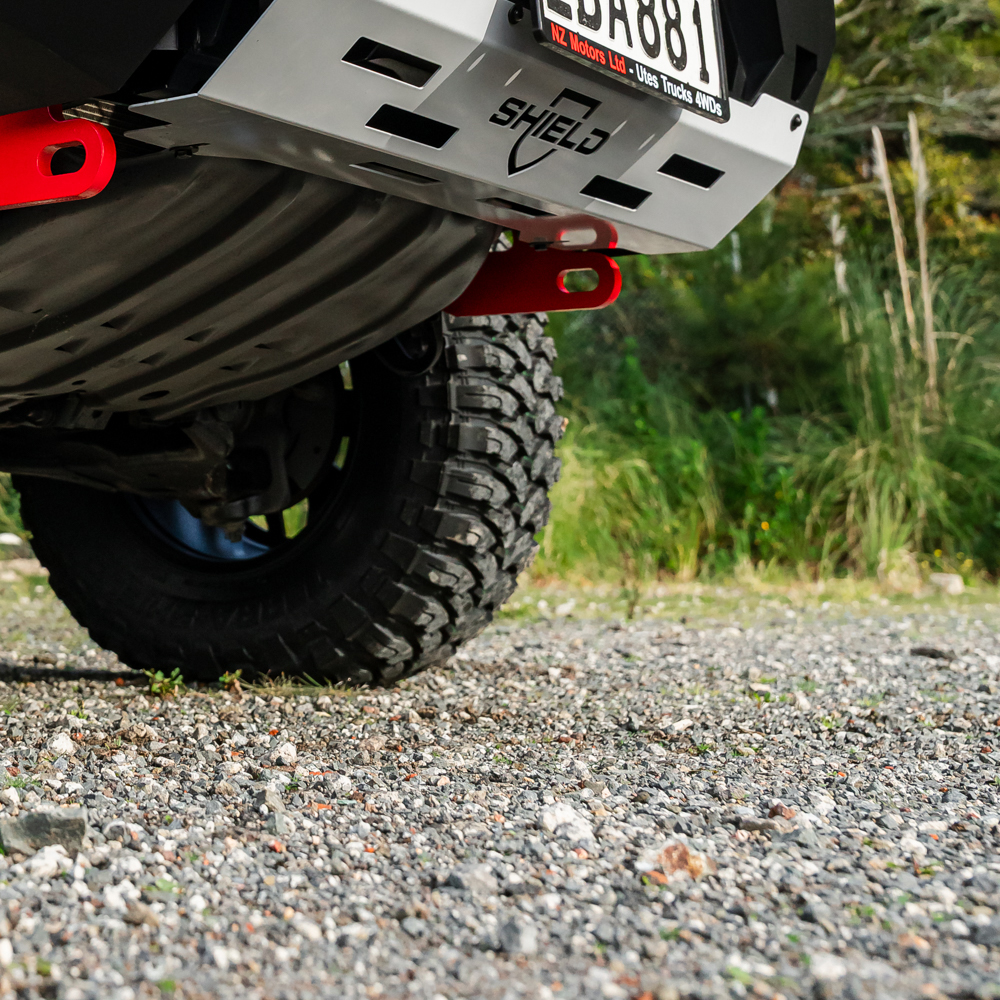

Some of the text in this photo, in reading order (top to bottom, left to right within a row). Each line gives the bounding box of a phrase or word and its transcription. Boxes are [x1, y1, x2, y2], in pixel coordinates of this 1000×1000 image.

[550, 22, 568, 48] NZ
[569, 31, 606, 65] Motors
[608, 50, 627, 75] Ltd
[636, 63, 659, 88] Utes
[660, 73, 693, 105] Trucks
[695, 91, 723, 117] 4WDs
[488, 96, 611, 156] SHIELD
